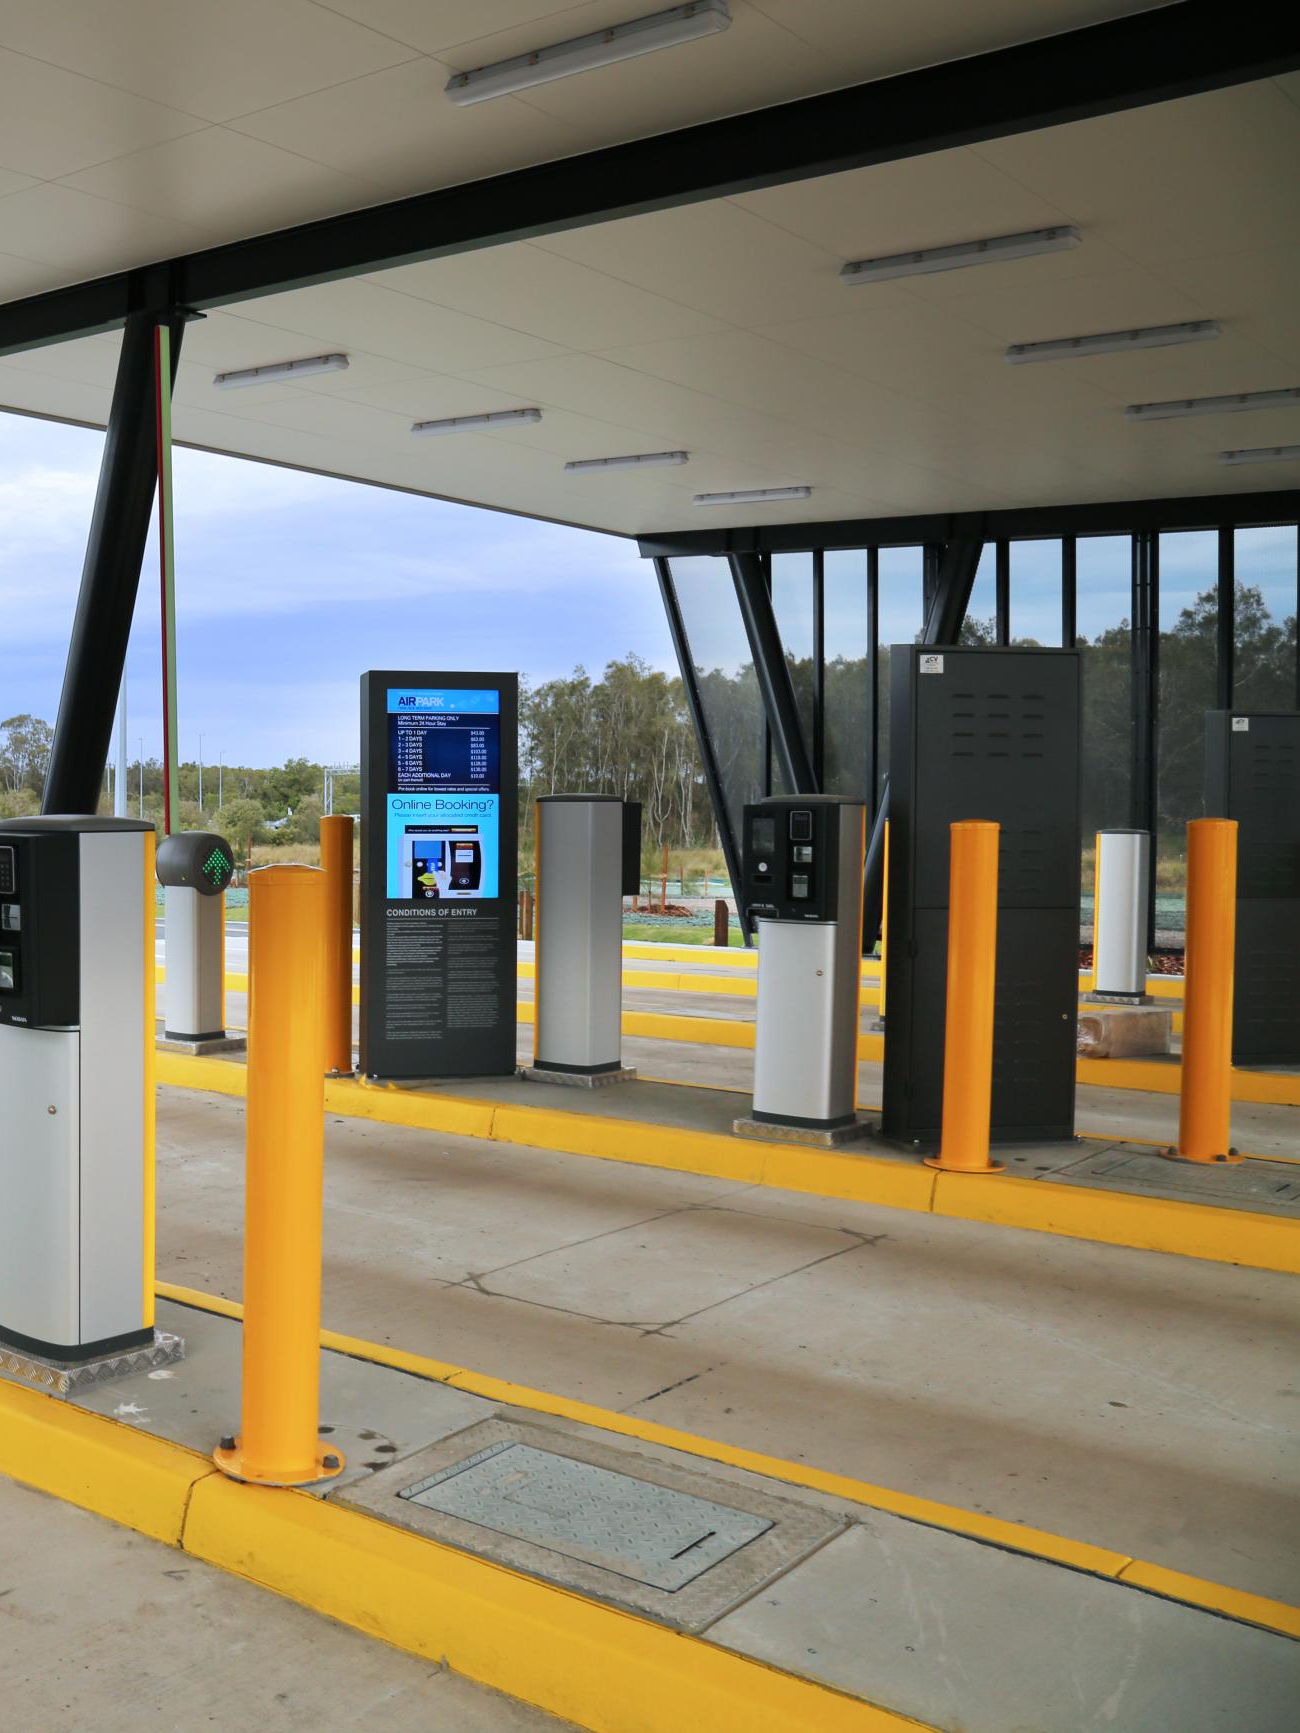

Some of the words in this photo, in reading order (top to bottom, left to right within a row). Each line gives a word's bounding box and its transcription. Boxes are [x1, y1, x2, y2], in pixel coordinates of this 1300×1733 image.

[398, 697, 444, 706] AIRPARK
[392, 799, 432, 810] Online
[436, 799, 494, 812] Booking?
